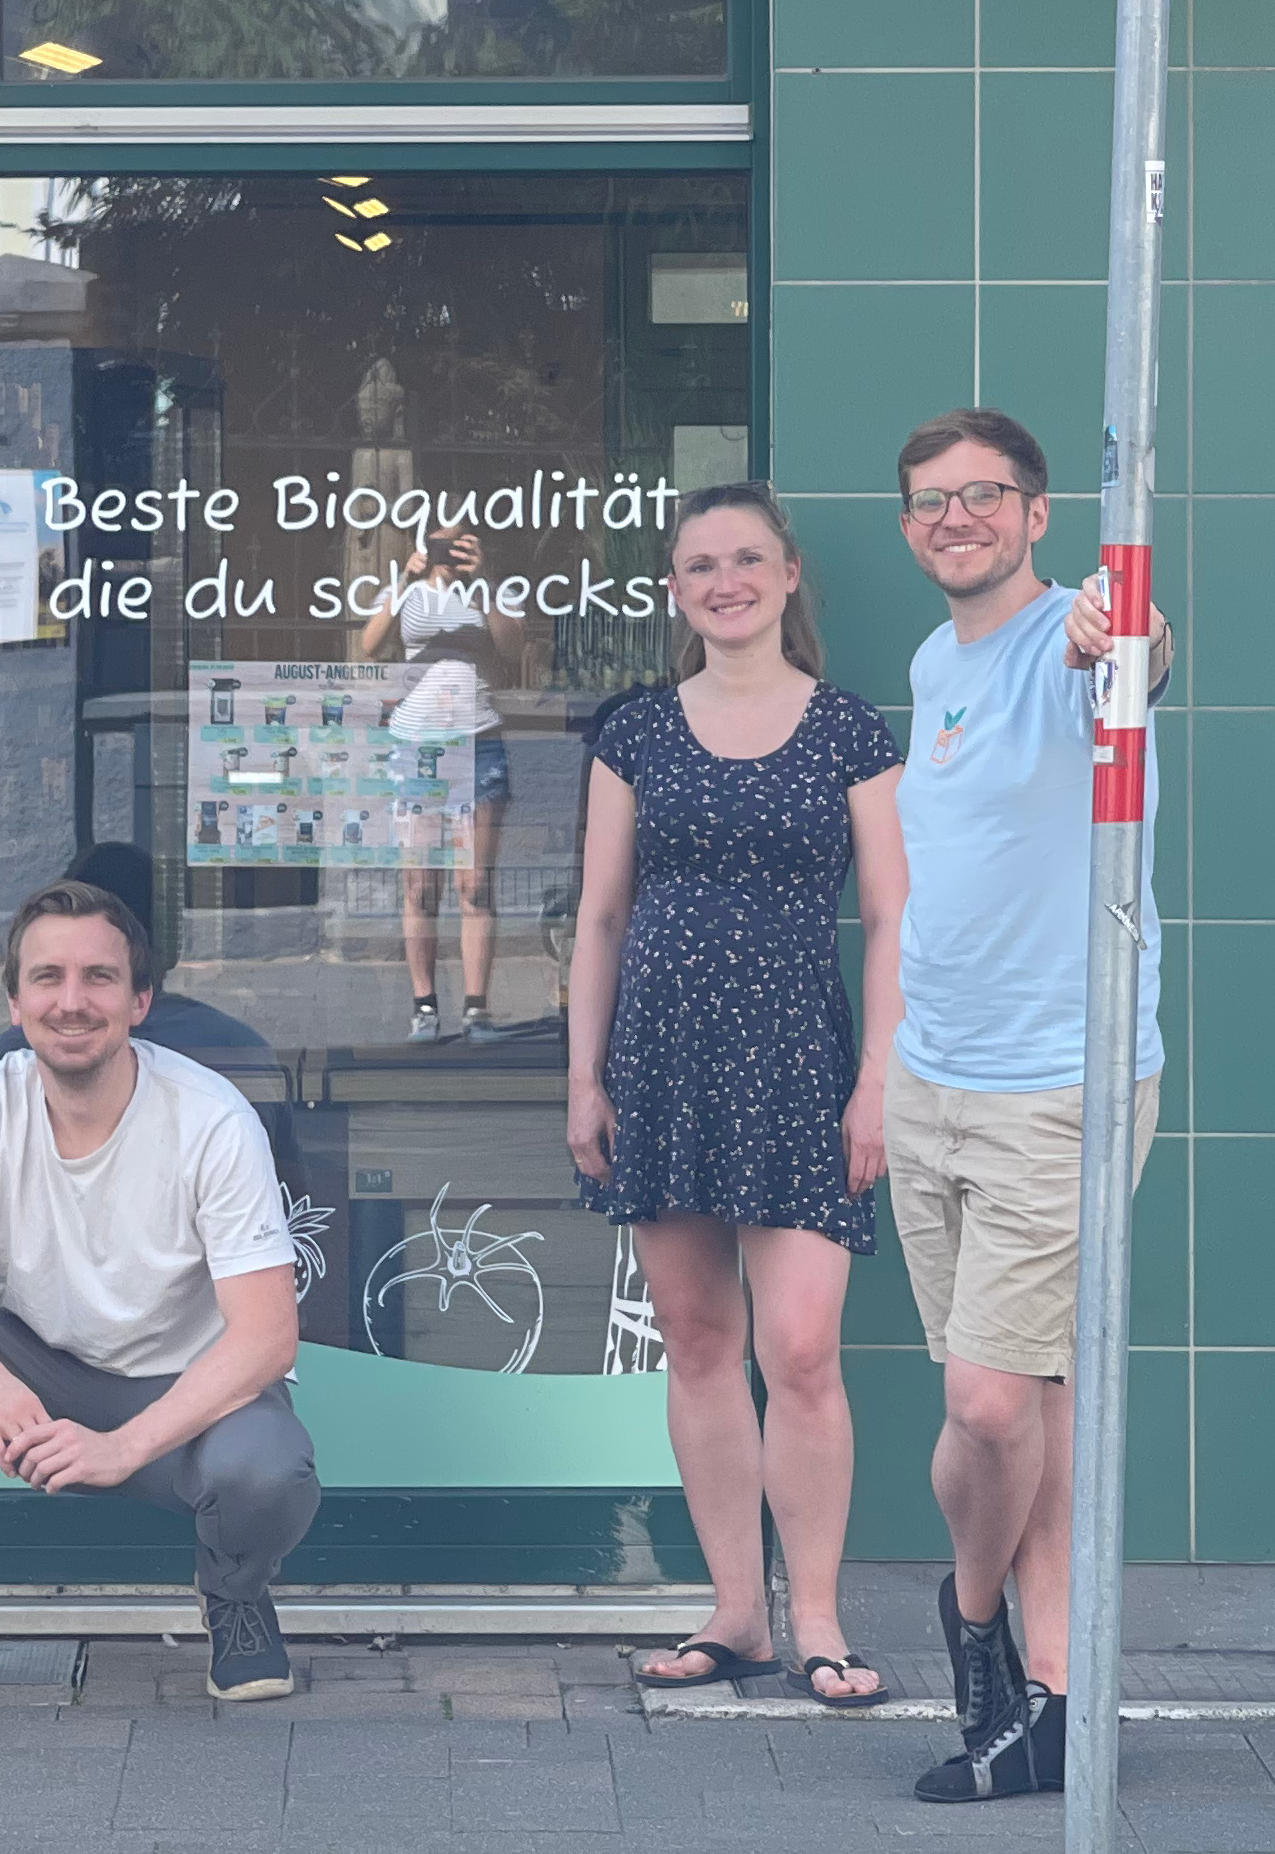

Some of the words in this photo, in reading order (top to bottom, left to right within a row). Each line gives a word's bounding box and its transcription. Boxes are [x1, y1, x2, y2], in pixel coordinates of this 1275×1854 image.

[40, 477, 240, 531] Beste
[273, 469, 680, 556] Bioqualität
[49, 558, 153, 619] die
[185, 558, 276, 619] du
[274, 664, 389, 681] AUGUST-ANGEBOTE
